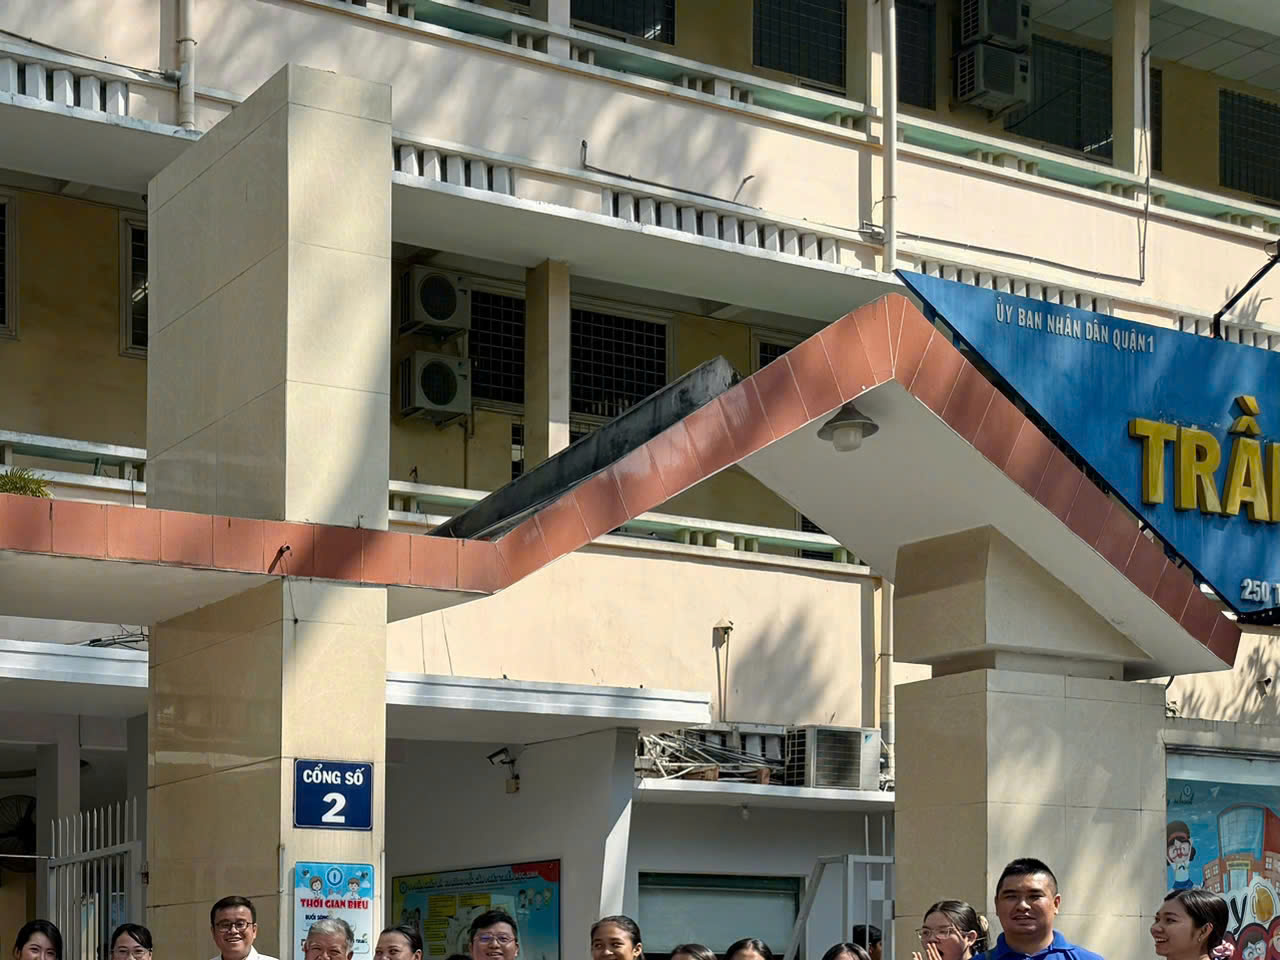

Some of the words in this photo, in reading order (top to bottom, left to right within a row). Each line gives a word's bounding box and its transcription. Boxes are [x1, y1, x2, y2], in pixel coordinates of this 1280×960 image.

[996, 297, 1013, 323] ỦY
[1018, 308, 1042, 330] BAN
[1047, 313, 1081, 339] NHÂN
[1085, 319, 1109, 344] DÂN
[1128, 395, 1280, 522] TRẦ
[1240, 578, 1270, 602] 250
[303, 763, 341, 785] CỔNG
[344, 767, 365, 786] SỐ
[321, 792, 346, 824] 2
[324, 899, 346, 909] GIAN
